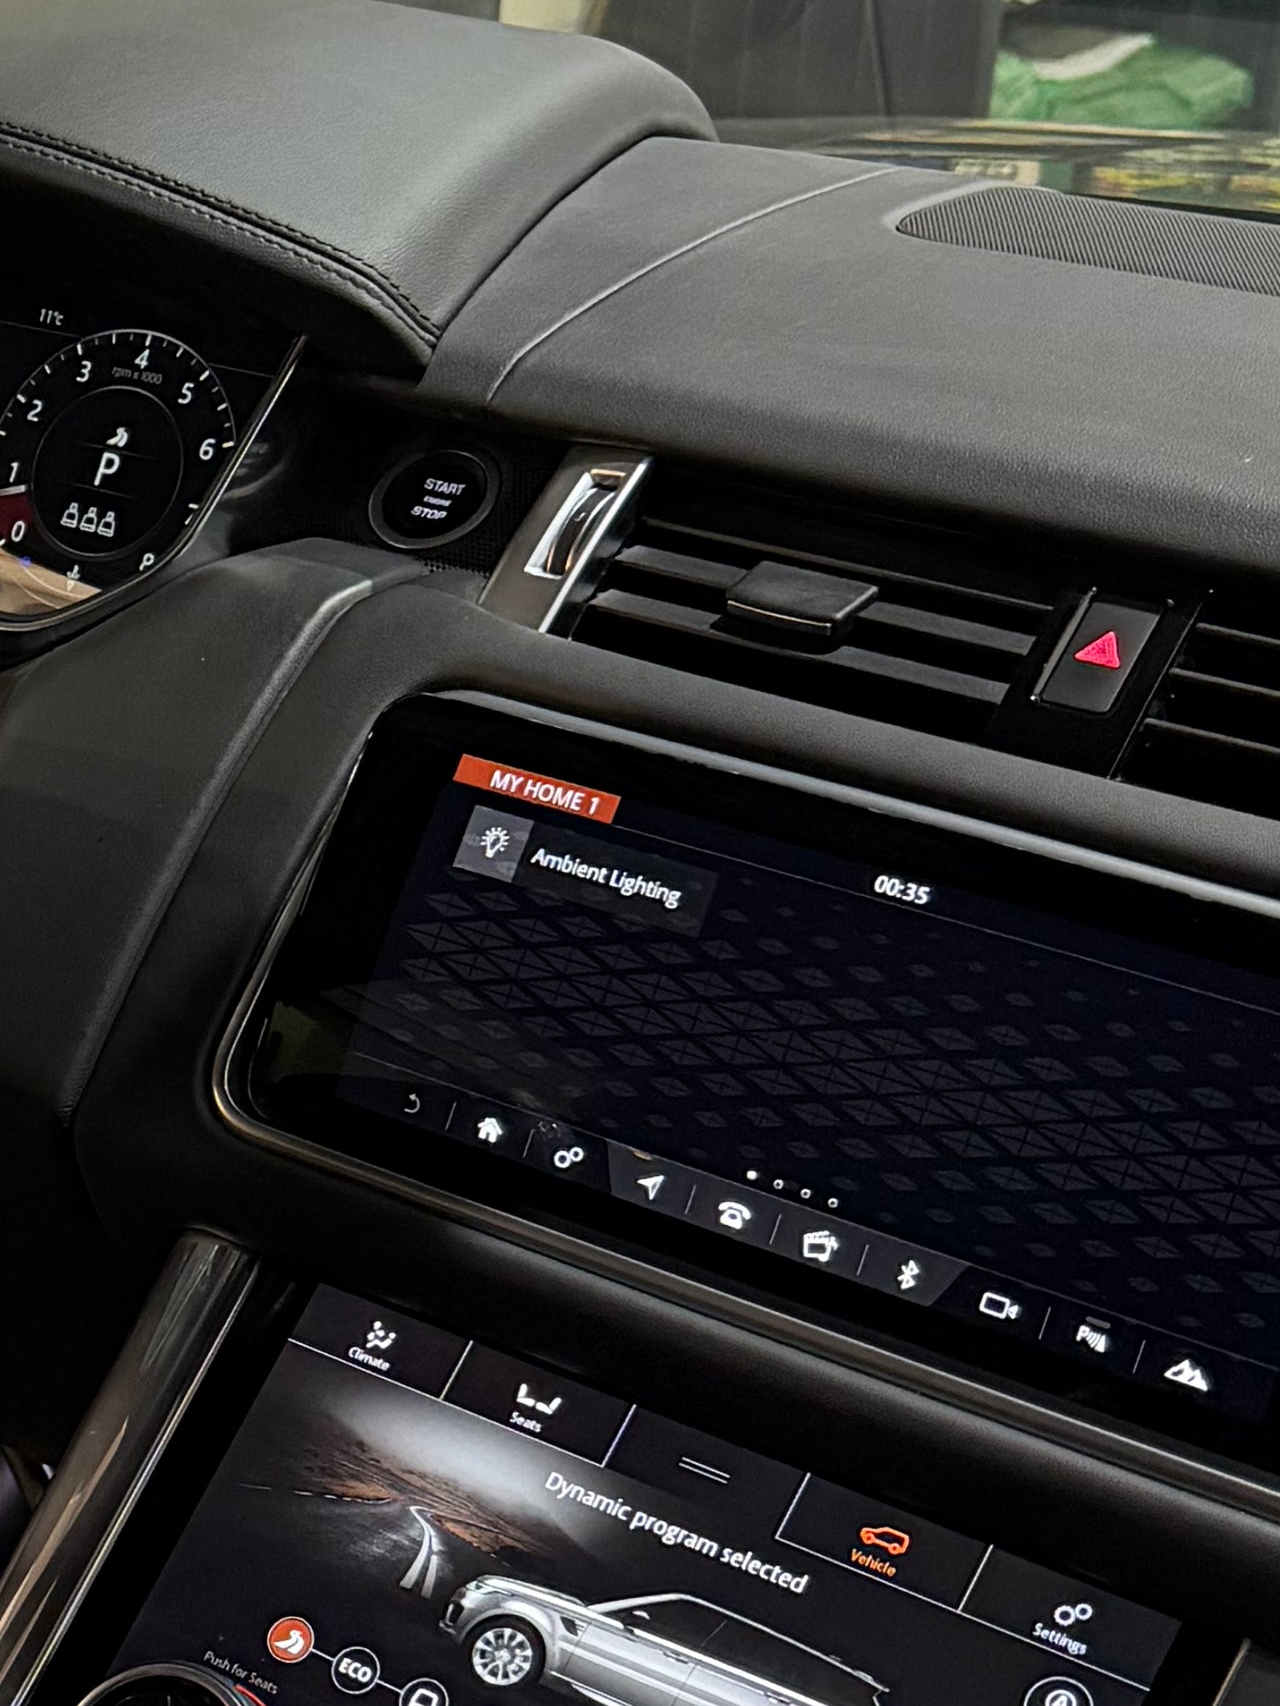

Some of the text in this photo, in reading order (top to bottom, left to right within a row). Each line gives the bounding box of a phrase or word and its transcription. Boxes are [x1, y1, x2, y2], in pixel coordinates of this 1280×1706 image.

[75, 359, 93, 383] 3
[133, 348, 151, 370] 4
[176, 381, 196, 405] 5
[26, 399, 44, 423] 2
[198, 437, 217, 462] 6
[8, 461, 21, 484] 1
[93, 450, 122, 487] P
[423, 477, 467, 496] START
[410, 504, 448, 521] STOP
[10, 519, 27, 543] 0
[488, 768, 602, 815] MY HOME 1
[529, 847, 683, 910] Ambient Lighting
[873, 874, 931, 906] 00:35
[347, 1345, 392, 1373] Climate
[508, 1410, 543, 1434] Seats
[543, 1471, 810, 1595] Dynamic program selected
[849, 1547, 898, 1579] Vehicle
[1031, 1621, 1088, 1657] Settings
[203, 1649, 280, 1696] Push for Seats
[337, 1656, 373, 1684] ECO
